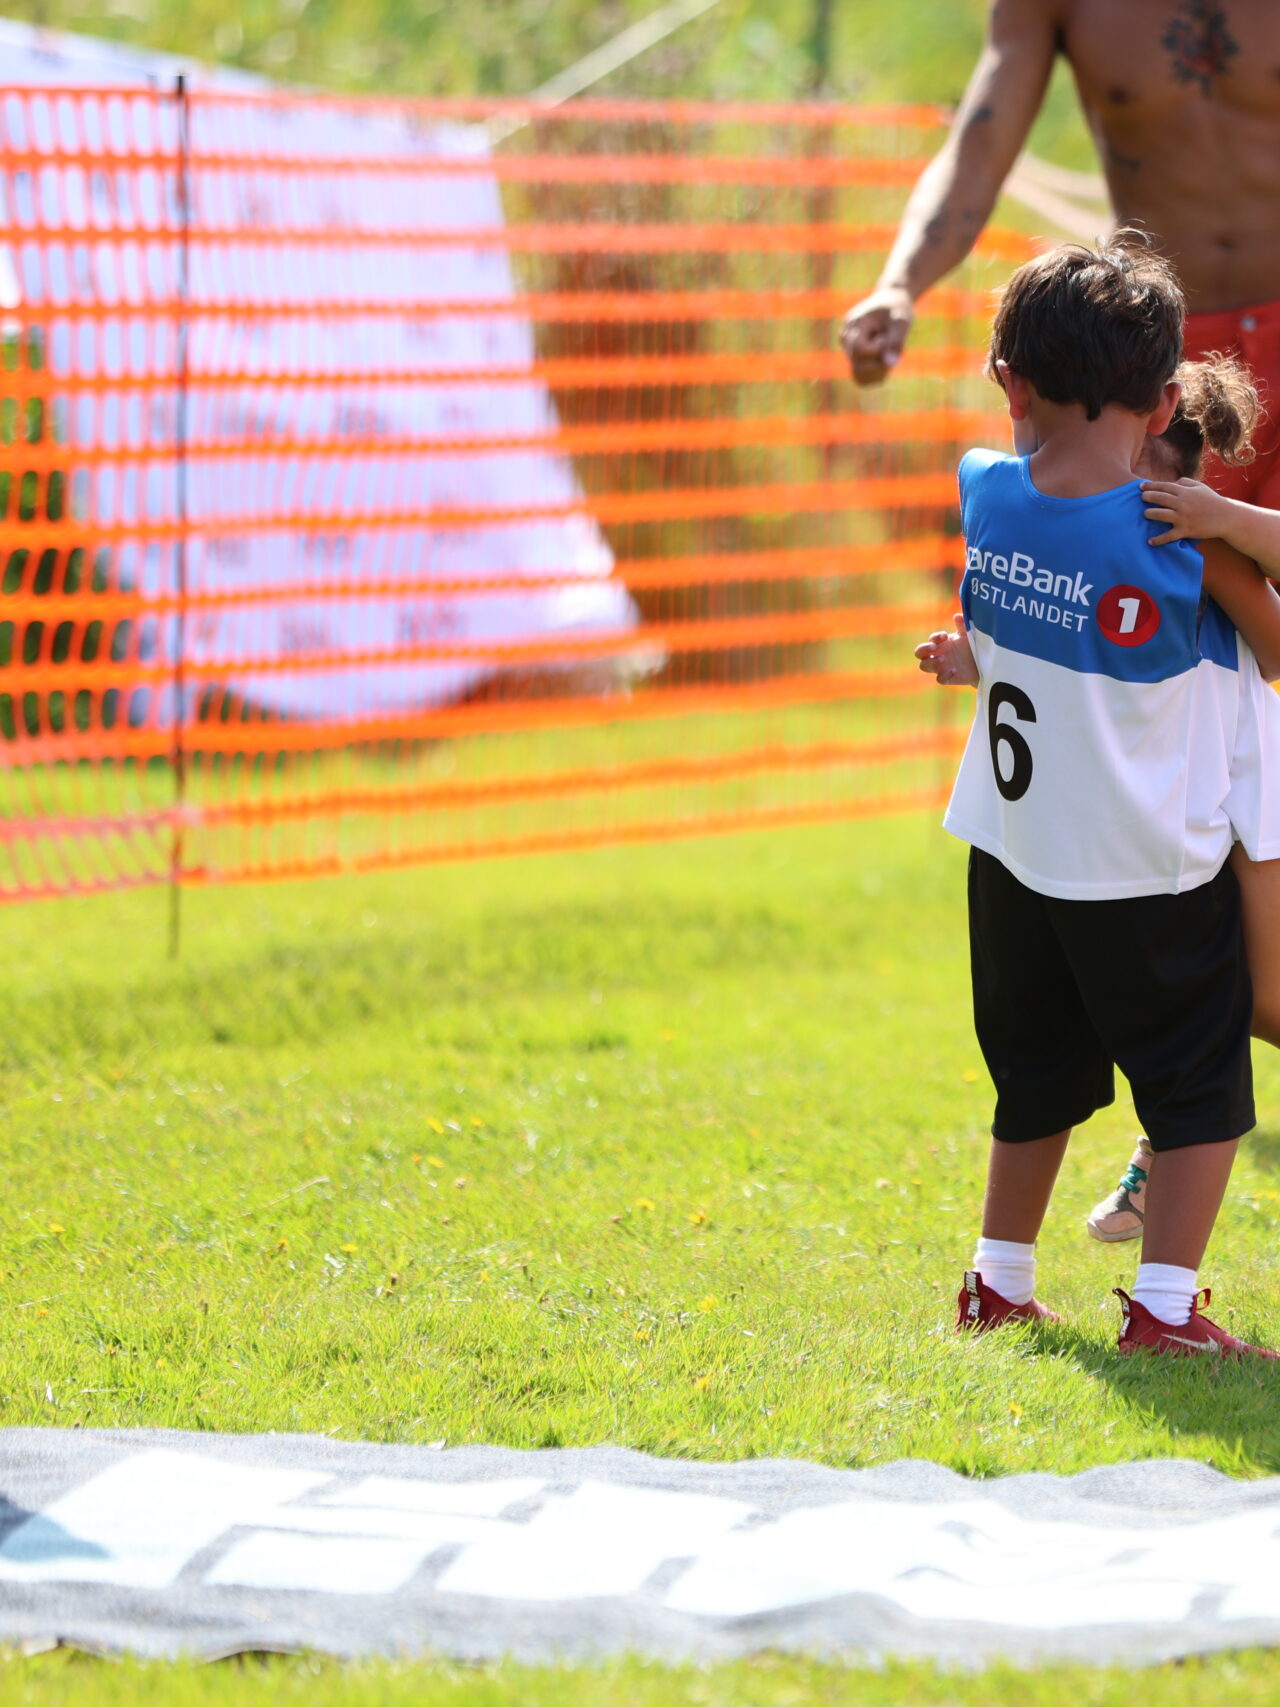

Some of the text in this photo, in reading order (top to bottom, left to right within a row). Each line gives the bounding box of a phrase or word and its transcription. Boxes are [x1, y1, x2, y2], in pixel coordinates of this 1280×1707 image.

[966, 546, 1141, 634] areBank 1
[971, 577, 1089, 632] ØSTLANDET
[988, 681, 1038, 802] 6
[966, 1271, 977, 1295] NIKE
